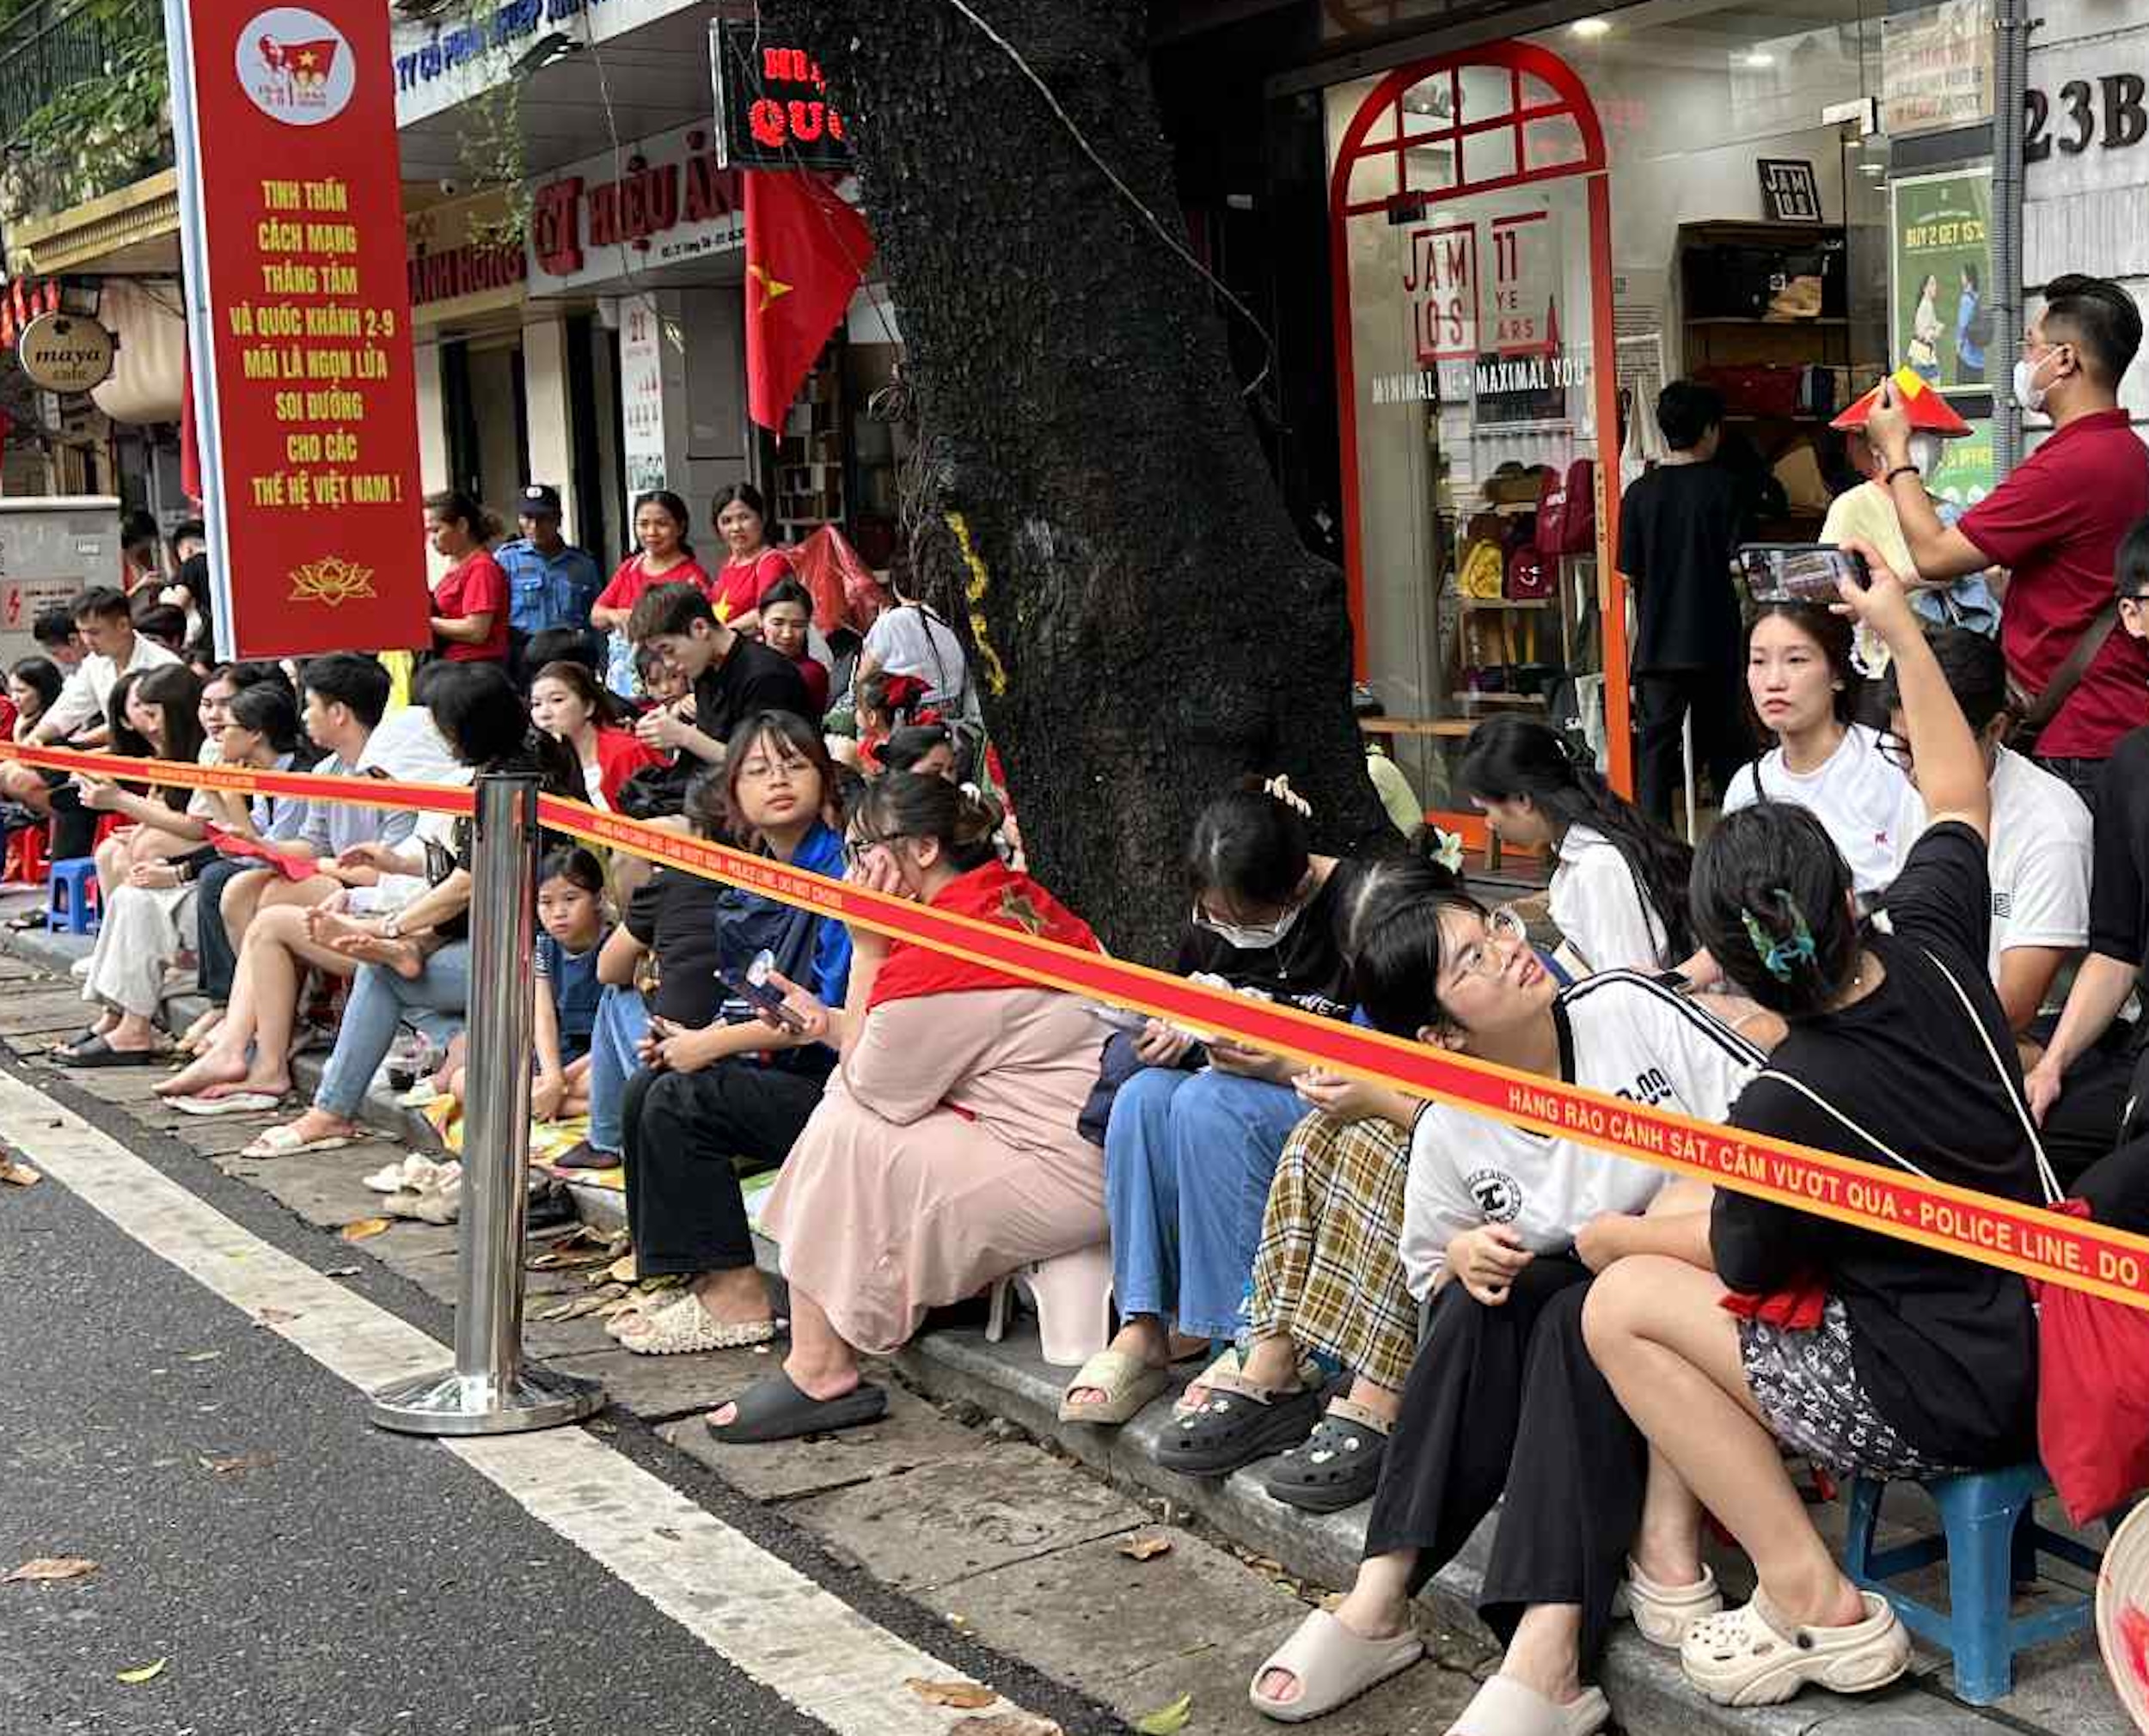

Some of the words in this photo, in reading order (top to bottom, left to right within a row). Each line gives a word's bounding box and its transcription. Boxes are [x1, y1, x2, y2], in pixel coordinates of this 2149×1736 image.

[260, 180, 301, 210] TINH
[258, 217, 303, 252] CÁCH
[306, 223, 358, 259] MẠNG
[261, 259, 318, 293] THÁNG
[319, 260, 358, 294] TÁM
[229, 300, 254, 336] VÀ
[256, 301, 303, 336] QUỐC
[304, 302, 361, 336] KHÁNH
[364, 308, 395, 337] 2-9
[34, 346, 100, 364] maya
[243, 343, 278, 379] MÃI
[281, 344, 303, 379] LÀ
[306, 349, 352, 383] NGỌN
[1372, 371, 1436, 405] MINIMAL
[1474, 358, 1548, 394] MAXIMAL
[1551, 354, 1586, 387] YOU
[275, 391, 303, 420] SOI
[286, 434, 321, 462] CHO
[324, 427, 358, 462] CÁC
[252, 471, 285, 506] THẾ
[287, 470, 309, 510] HỆ
[312, 470, 347, 510] VIỆT
[351, 476, 390, 502] NAM
[1508, 1084, 1559, 1122] HÀNG
[1563, 1100, 1605, 1134] RÀO
[1846, 1183, 1898, 1219] QUA
[1919, 1200, 2013, 1251] POLICE
[2020, 1228, 2090, 1274] LINE.
[2097, 1250, 2140, 1287] DO
